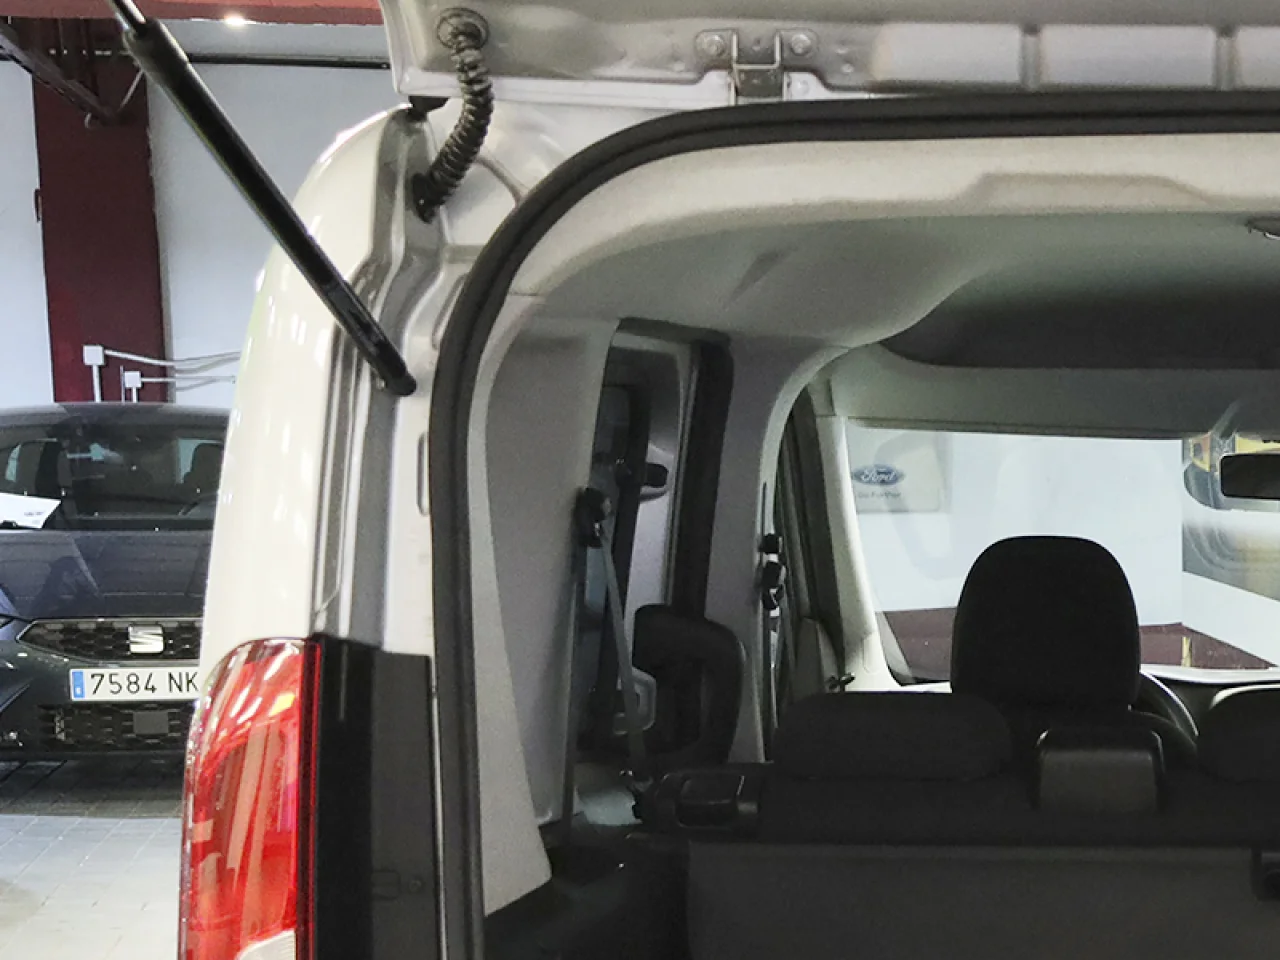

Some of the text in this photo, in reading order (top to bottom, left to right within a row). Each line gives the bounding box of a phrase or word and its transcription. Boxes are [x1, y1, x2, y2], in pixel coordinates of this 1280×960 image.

[858, 467, 897, 482] Ford
[90, 671, 199, 695] 7584 NK
